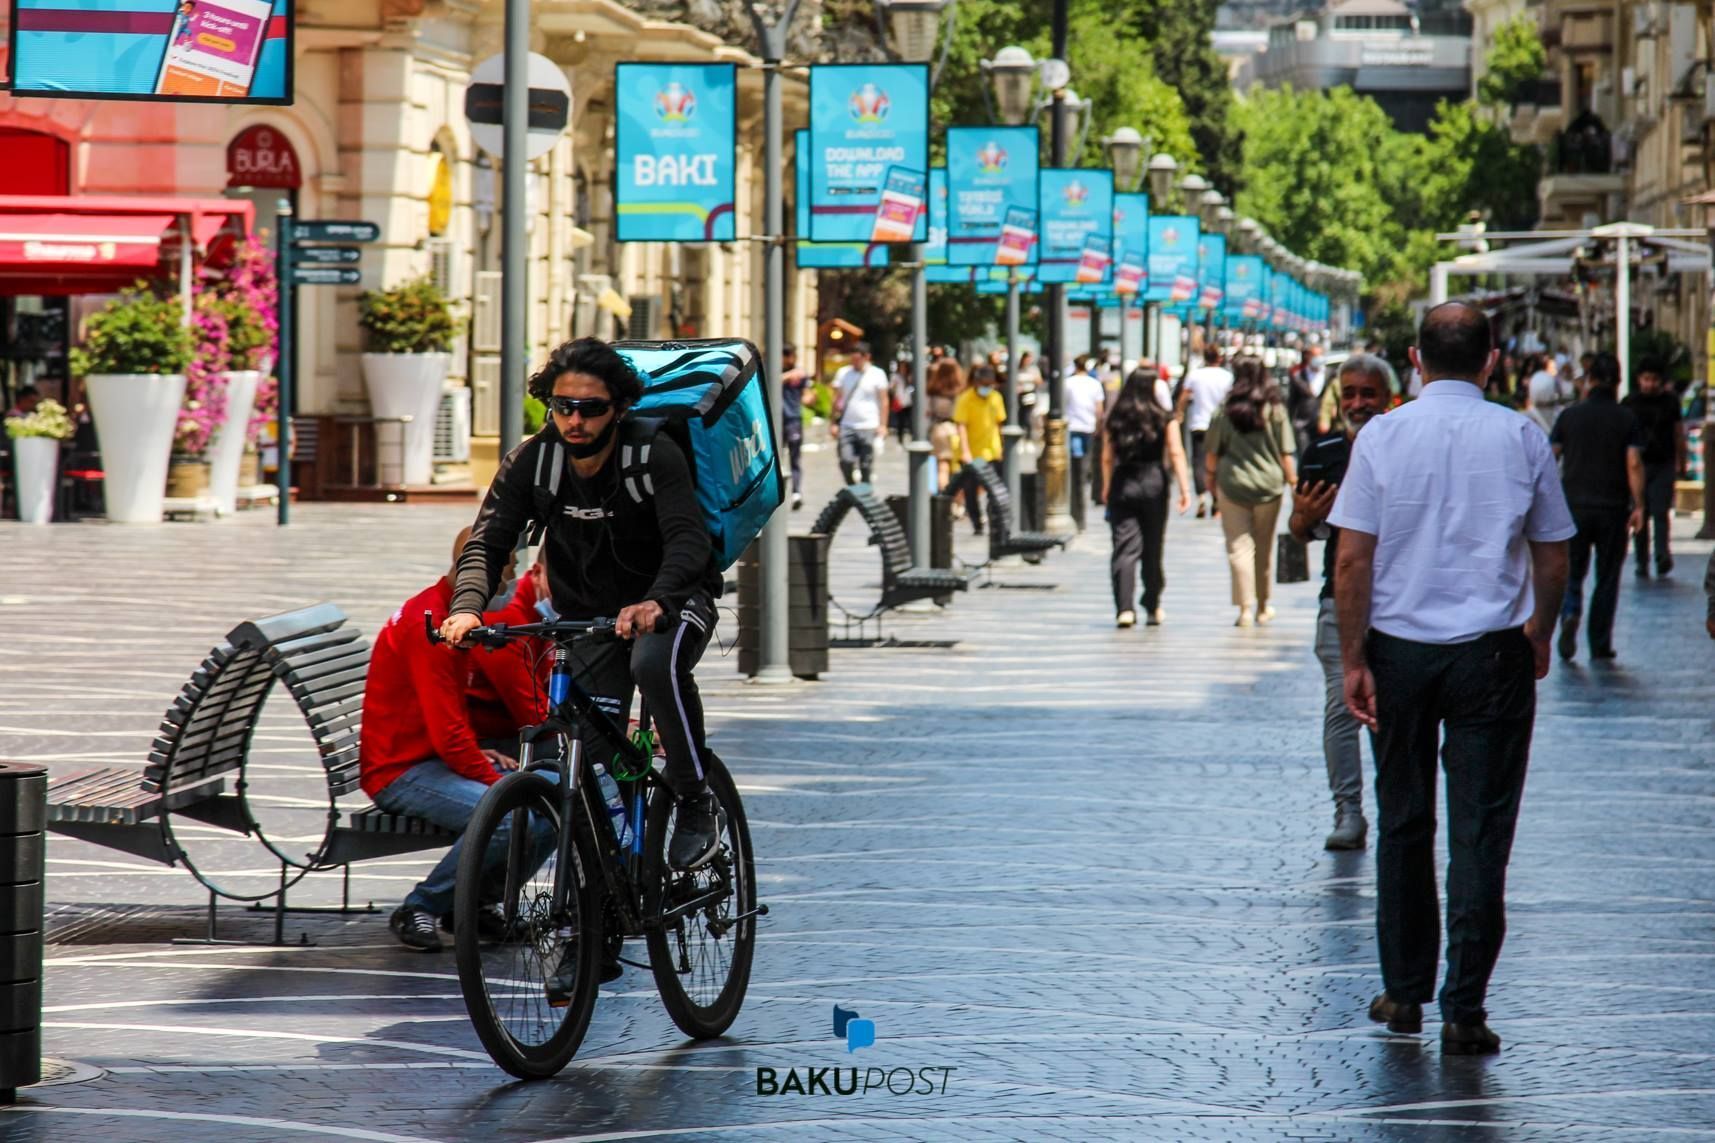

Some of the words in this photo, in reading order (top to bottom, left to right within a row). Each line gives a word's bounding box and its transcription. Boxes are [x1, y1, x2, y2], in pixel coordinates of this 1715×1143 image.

[825, 146, 904, 161] DOWNLOAD
[634, 153, 718, 186] BAKI
[826, 163, 853, 178] THE
[856, 163, 884, 177] APP
